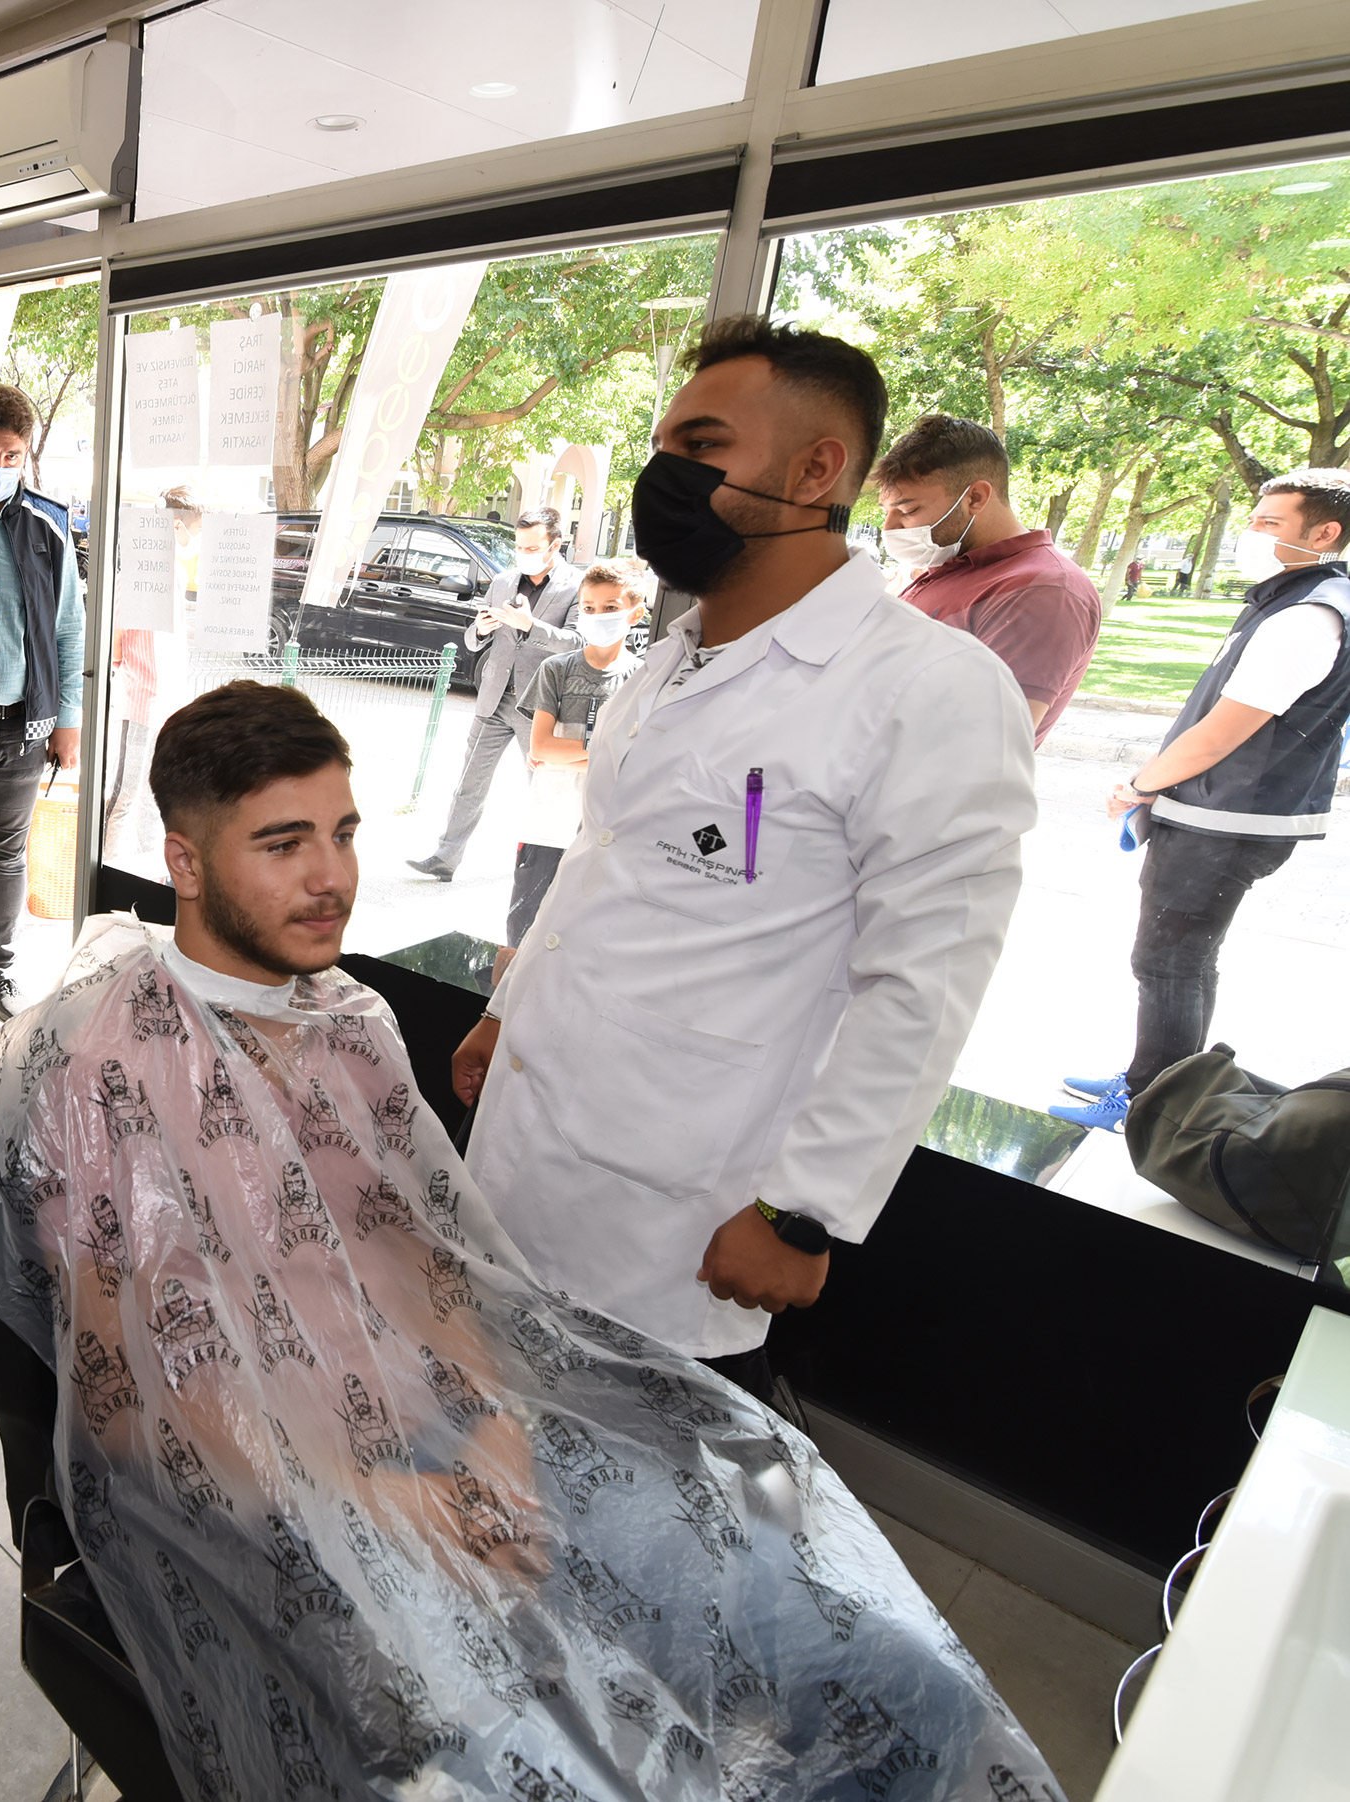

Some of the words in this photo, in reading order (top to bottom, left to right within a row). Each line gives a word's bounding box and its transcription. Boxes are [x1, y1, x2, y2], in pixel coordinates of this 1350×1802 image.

[656, 840, 687, 859] FATİH
[697, 831, 723, 850] FT
[666, 856, 701, 875] BERBER
[704, 871, 738, 886] SALON
